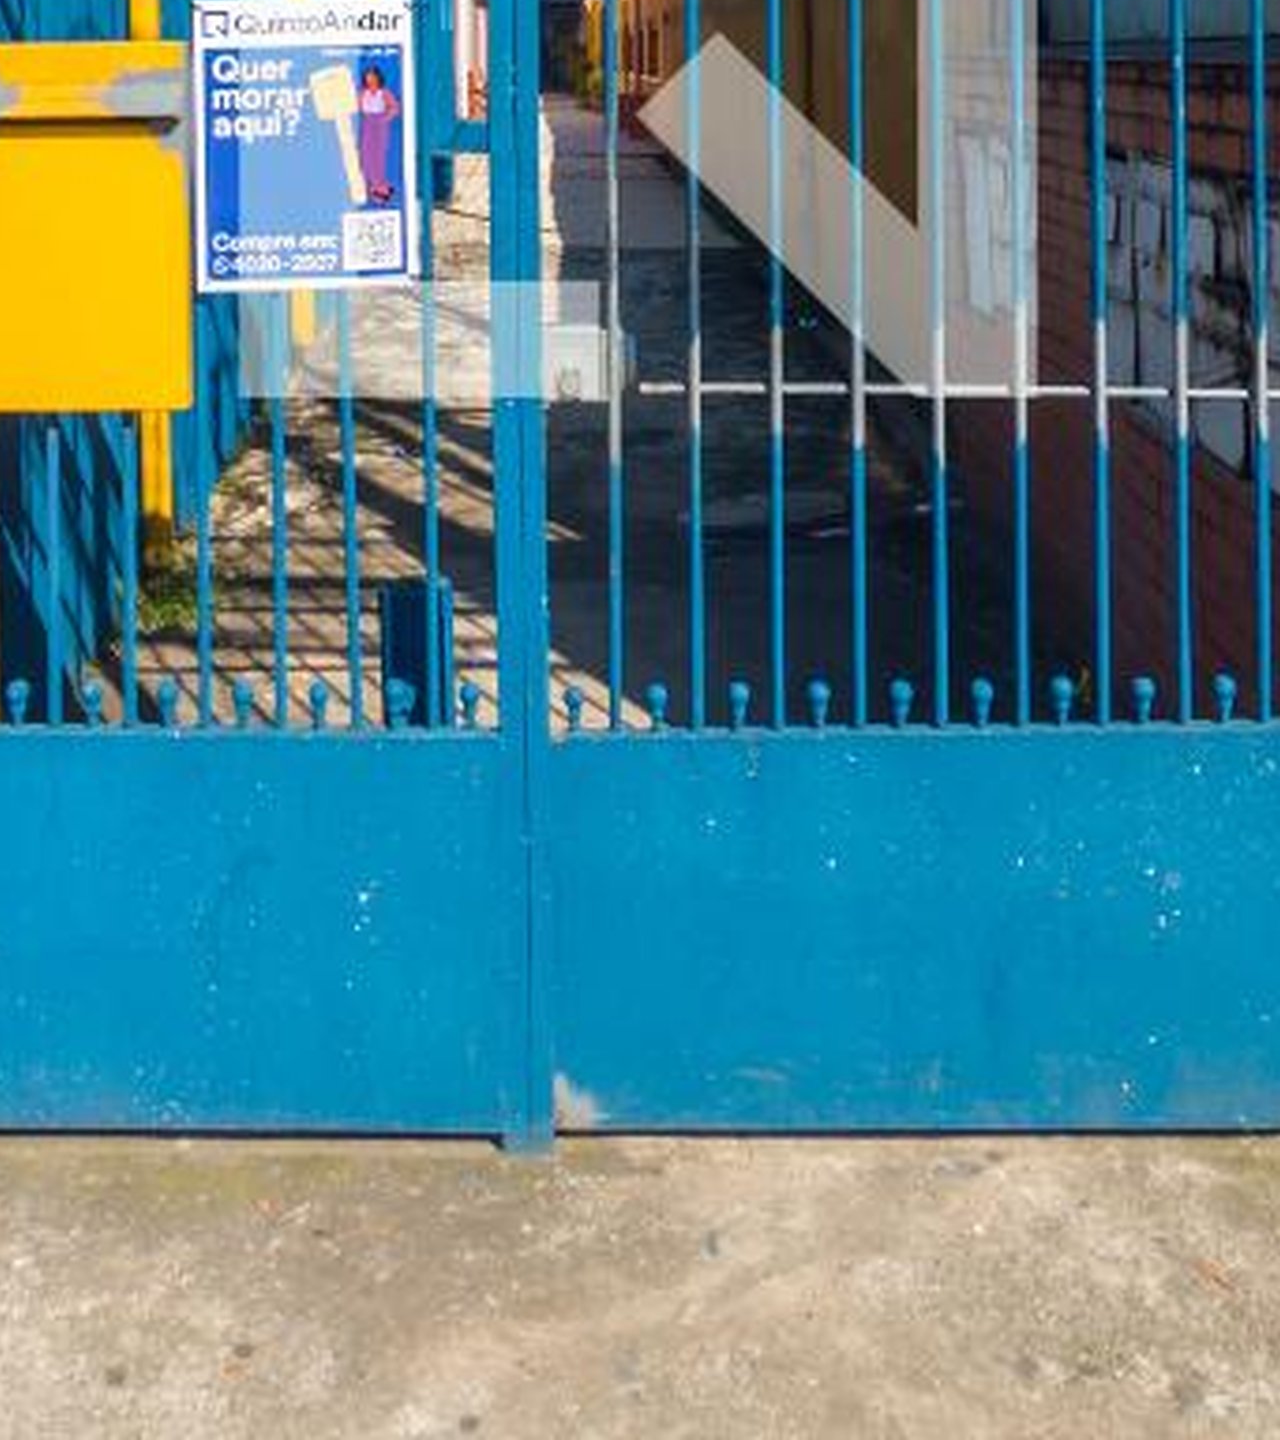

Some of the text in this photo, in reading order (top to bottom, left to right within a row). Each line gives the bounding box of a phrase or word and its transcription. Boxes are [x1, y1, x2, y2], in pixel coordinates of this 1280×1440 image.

[211, 54, 294, 84] Quer
[211, 87, 309, 112] morar
[211, 110, 302, 143] aqui?
